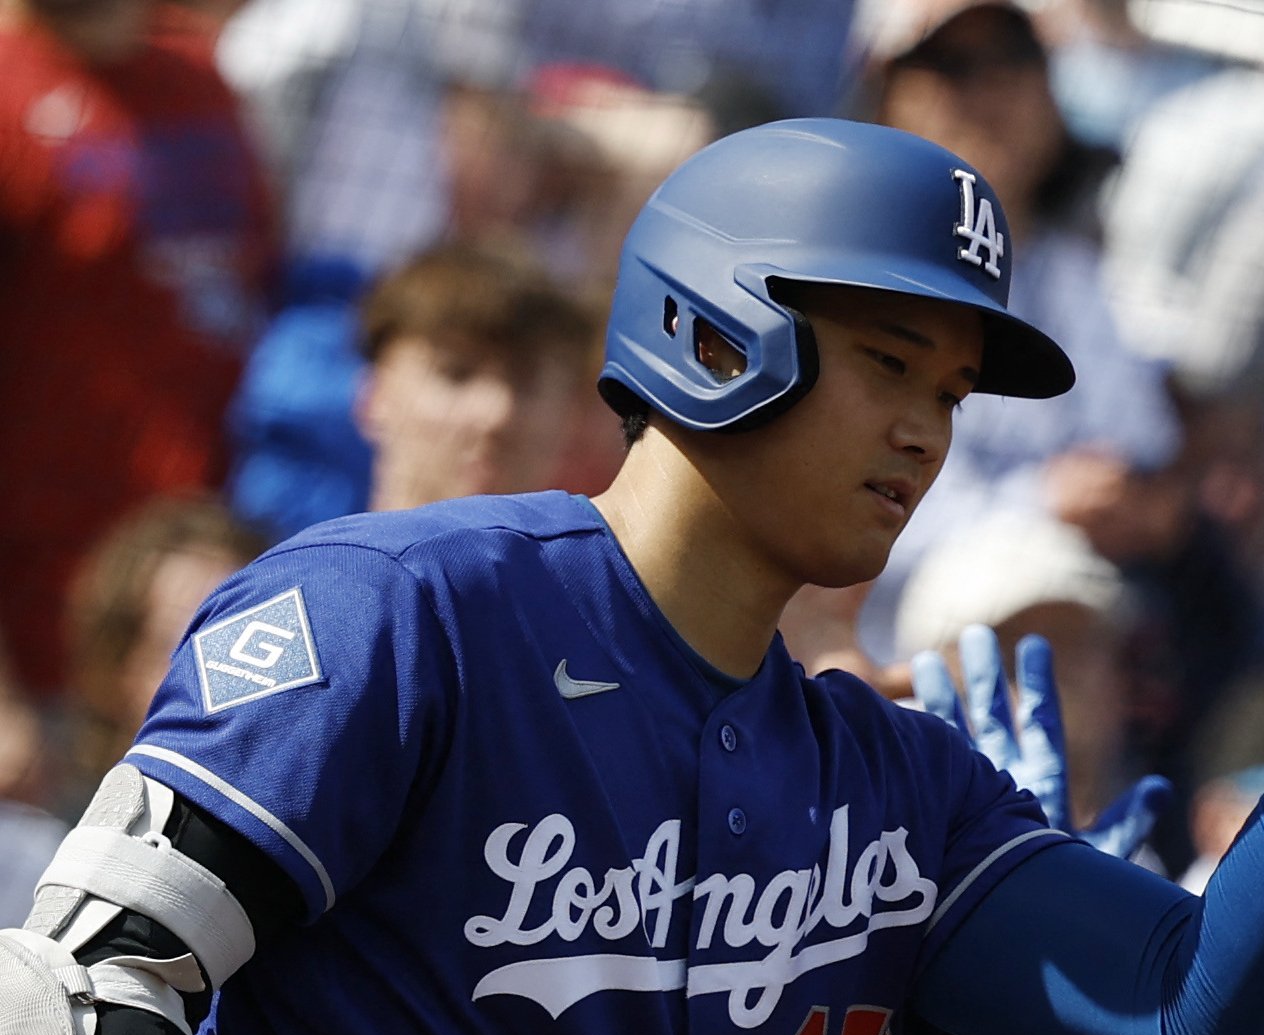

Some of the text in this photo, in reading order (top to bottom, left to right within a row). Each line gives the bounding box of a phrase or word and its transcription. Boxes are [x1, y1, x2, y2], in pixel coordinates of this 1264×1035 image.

[953, 169, 1004, 279] LA
[464, 803, 939, 1029] Los Angeles
